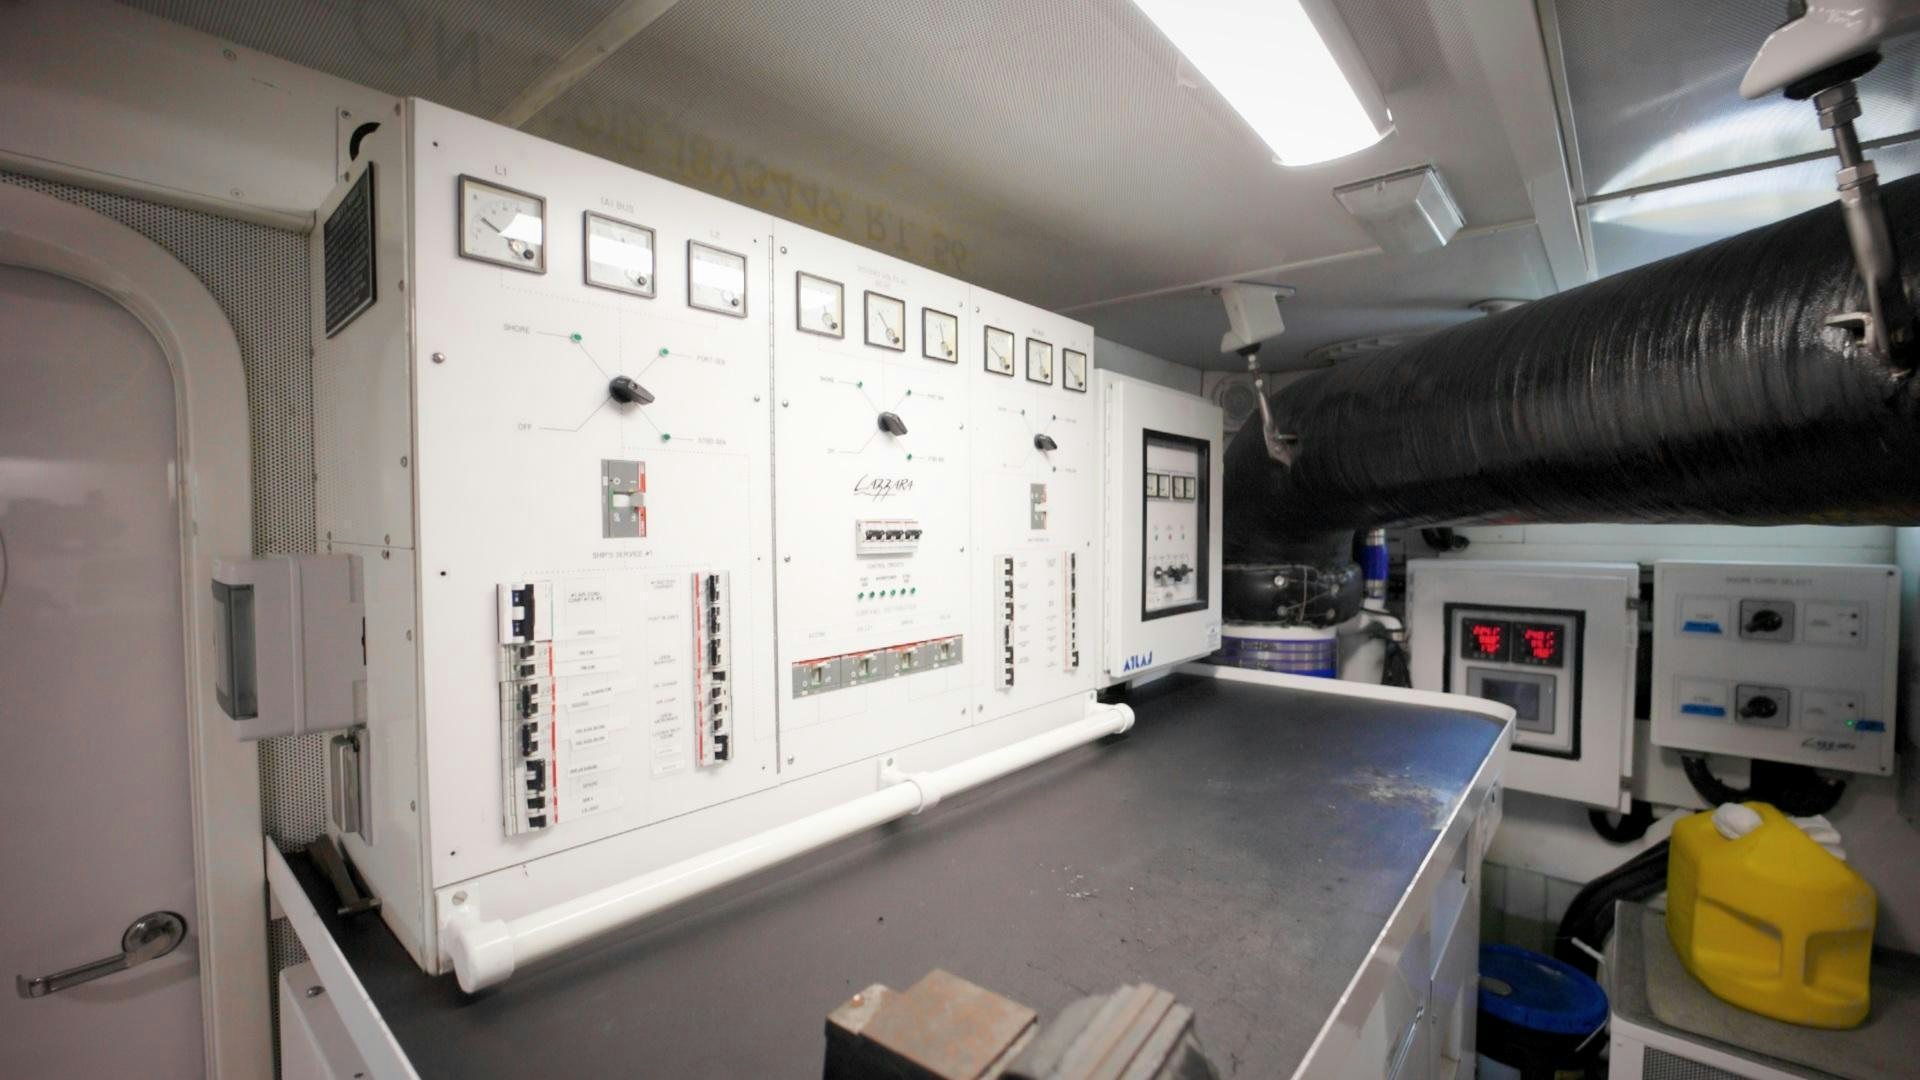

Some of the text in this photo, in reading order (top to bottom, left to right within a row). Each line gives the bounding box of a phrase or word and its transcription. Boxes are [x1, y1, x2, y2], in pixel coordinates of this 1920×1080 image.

[495, 164, 507, 177] L1
[503, 323, 531, 335] SHORE
[517, 422, 532, 432] OFF
